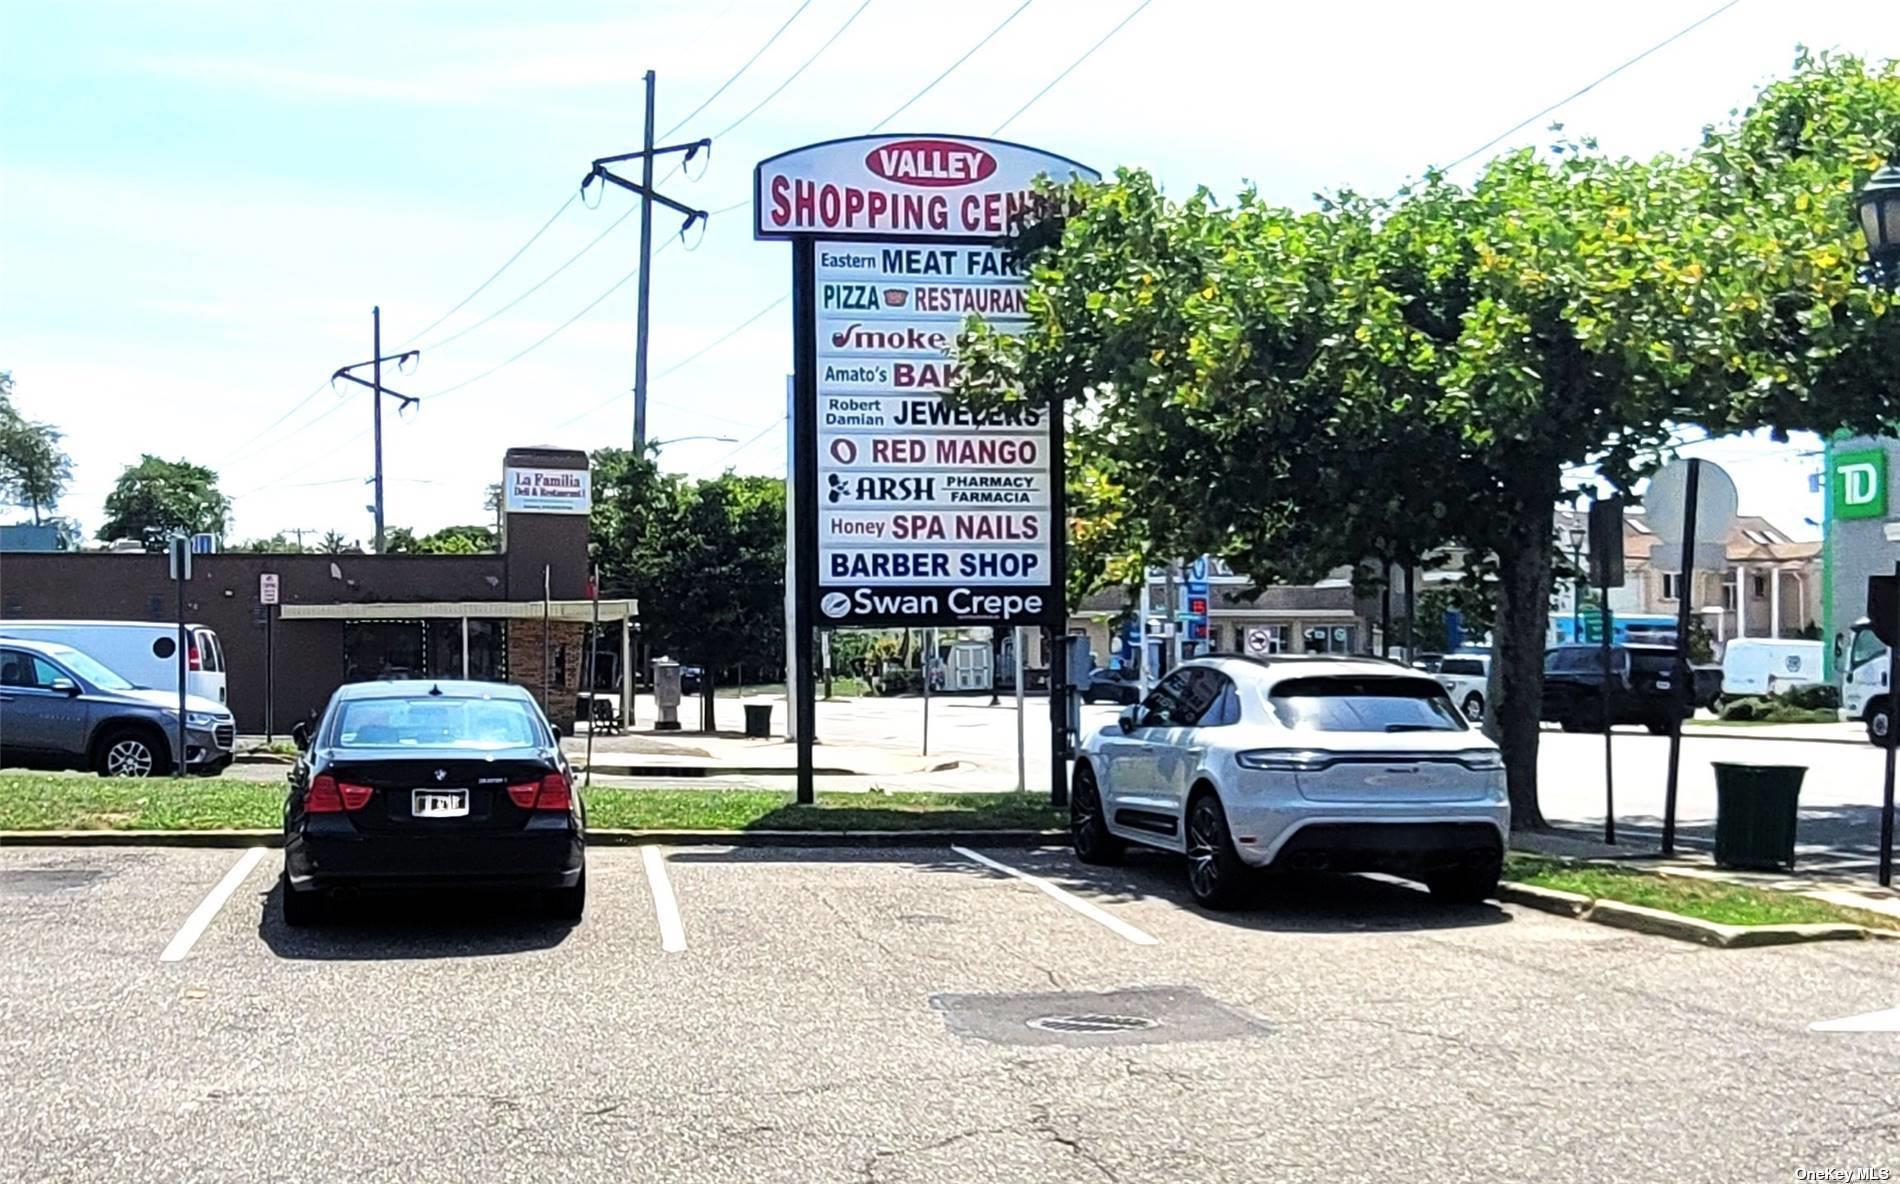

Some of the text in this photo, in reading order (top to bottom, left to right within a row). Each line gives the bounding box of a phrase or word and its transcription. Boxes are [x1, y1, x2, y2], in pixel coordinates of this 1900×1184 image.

[879, 149, 983, 179] VALLEY
[771, 174, 1070, 232] SHOPPING CEN
[821, 249, 1028, 277] Eastern MEAT FAR
[824, 285, 1030, 314] PIZZA RESTAURAN
[831, 324, 946, 349] Smoke
[824, 364, 888, 383] Amato's
[829, 398, 881, 411] Robert
[825, 413, 884, 426] Damian
[872, 439, 1037, 465] RED MANGO
[515, 472, 580, 488] La Familia
[856, 477, 935, 501] ARSH
[946, 476, 1034, 488] PHARMACY
[1837, 463, 1877, 505] TD
[951, 491, 1031, 503] FARMACIA
[831, 515, 1039, 540] Honey SPA NAILS
[831, 553, 1039, 578] BARBER SHOP
[854, 588, 1042, 619] Swan Crepe
